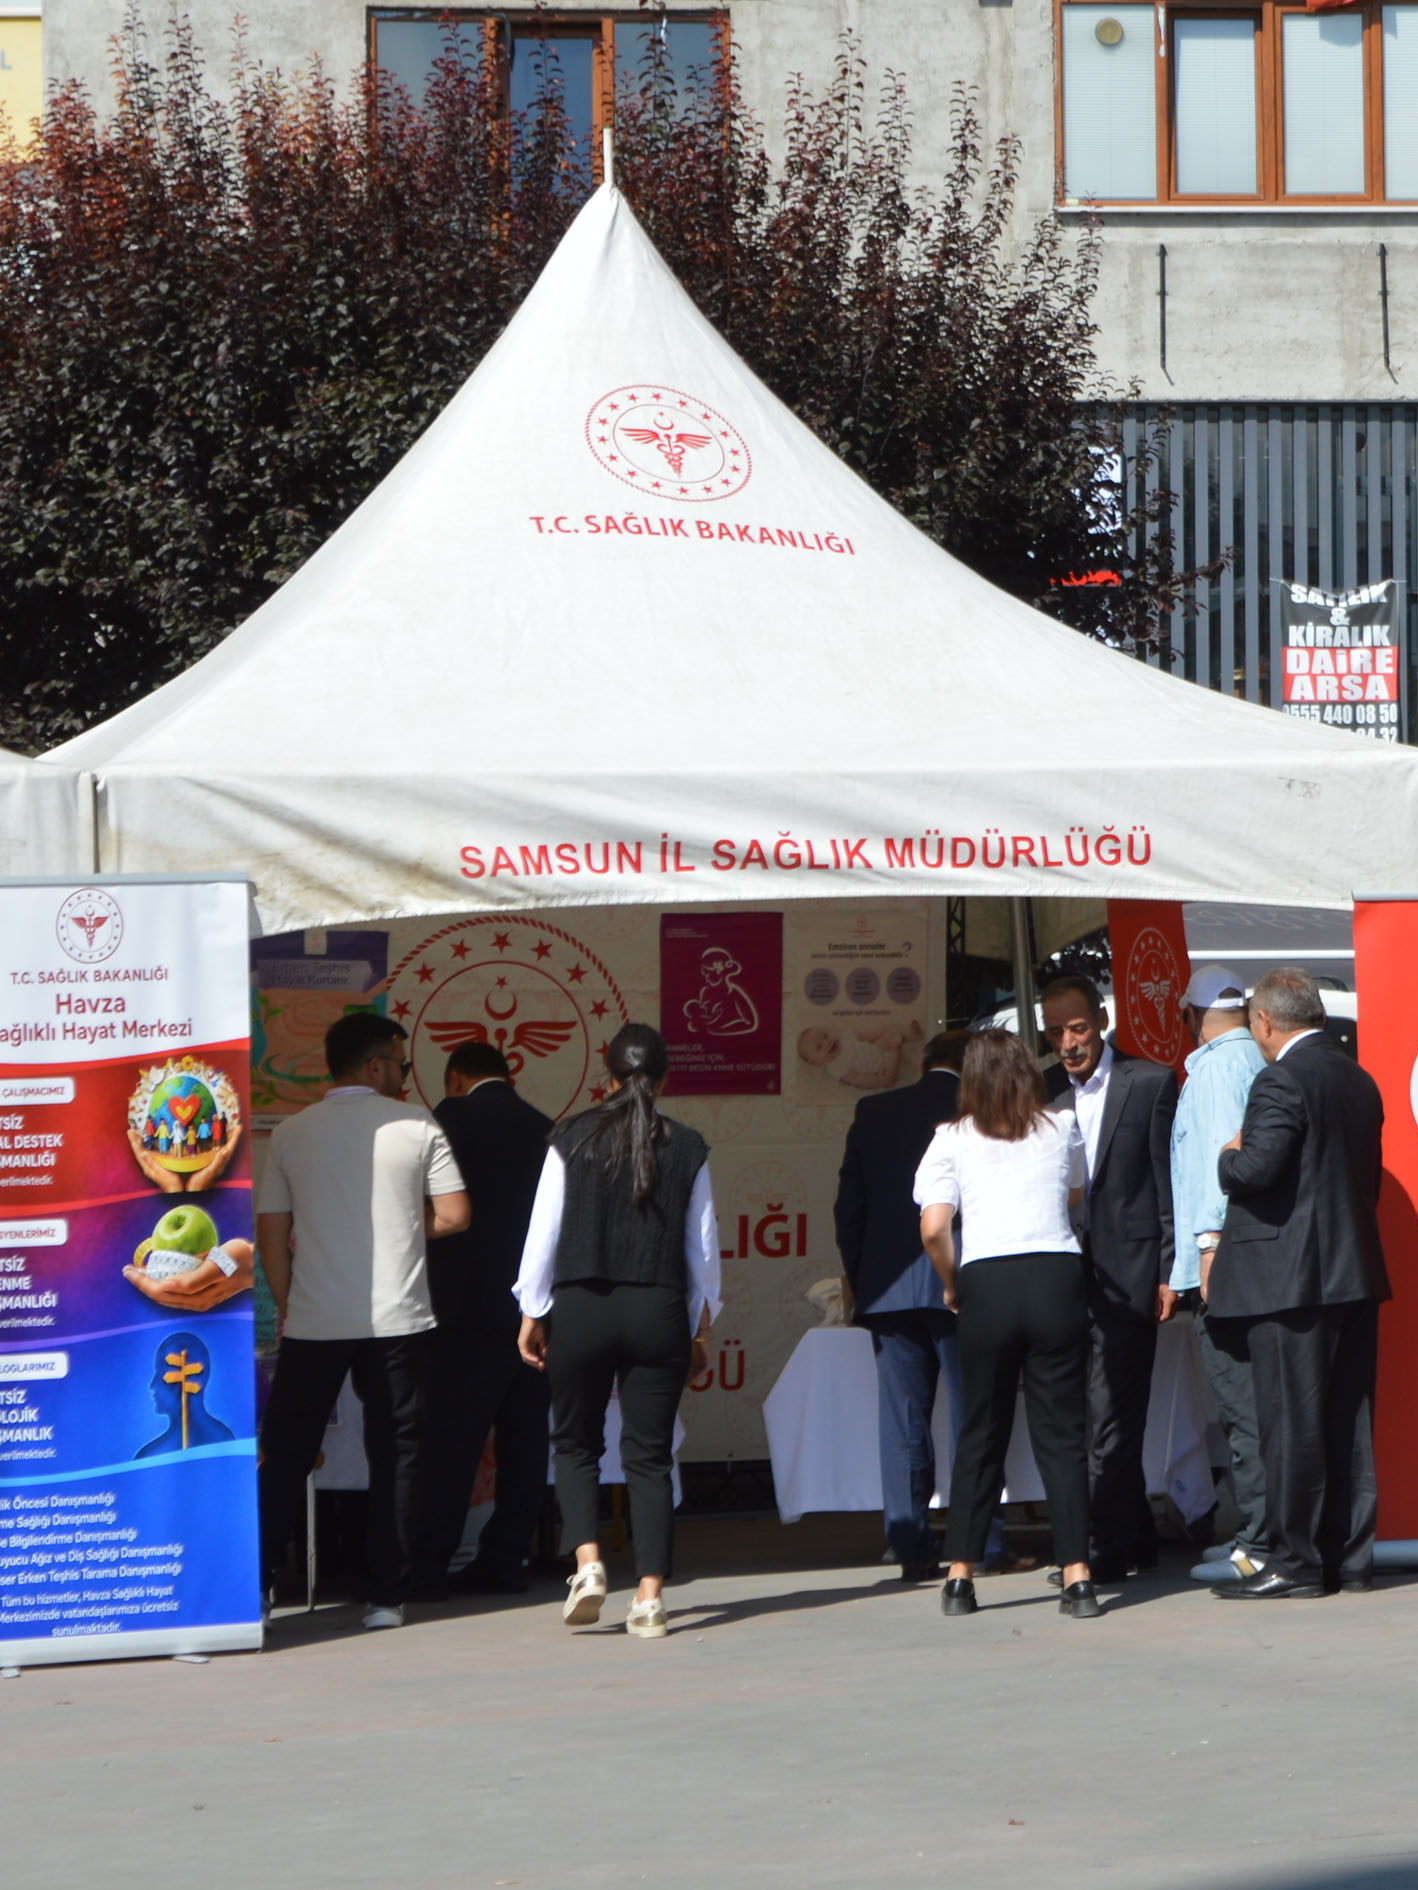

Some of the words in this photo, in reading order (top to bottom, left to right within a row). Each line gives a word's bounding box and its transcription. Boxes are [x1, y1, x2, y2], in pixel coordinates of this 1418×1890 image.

[530, 516, 581, 536] T.C.
[585, 511, 689, 538] SAĞLIK
[696, 519, 855, 556] BAKANLIĞI
[1330, 607, 1350, 626] &
[1288, 621, 1391, 648] KİRALIK
[1290, 675, 1390, 701] ARSA
[1323, 704, 1351, 724] 440
[1356, 704, 1376, 724] 08
[1379, 703, 1398, 724] 50
[460, 839, 643, 879] SAMSUN
[660, 832, 697, 873] İL
[711, 831, 871, 872] SAĞLIK
[885, 825, 1152, 869] MÜDÜRLÜĞÜ
[10, 972, 34, 985] T.C.
[38, 968, 88, 984] SAĞLIK
[93, 965, 168, 982] BAKANLIĞI
[56, 993, 126, 1015] Havza
[62, 1021, 116, 1045] Hayat
[122, 1017, 193, 1038] Merkezi
[14, 1133, 64, 1149] DESTEK
[0, 1405, 39, 1424] LOJİK
[13, 1494, 48, 1511] Öncesi
[51, 1491, 117, 1509] Danışmanlığı
[17, 1514, 51, 1531] Sağlığı
[53, 1509, 118, 1527] Danışmanlığı
[10, 1530, 74, 1549] Bilgilendirme
[75, 1526, 138, 1544] Danışmanlığı
[55, 1552, 66, 1562] ve
[69, 1549, 85, 1564] Diş
[87, 1546, 120, 1563] Sağlığı
[121, 1543, 184, 1559] Danışmanlığı
[18, 1571, 48, 1585] Erken
[49, 1566, 80, 1584] Teşhis
[82, 1564, 118, 1580] Tarama
[120, 1561, 183, 1578] Danışmanlığı
